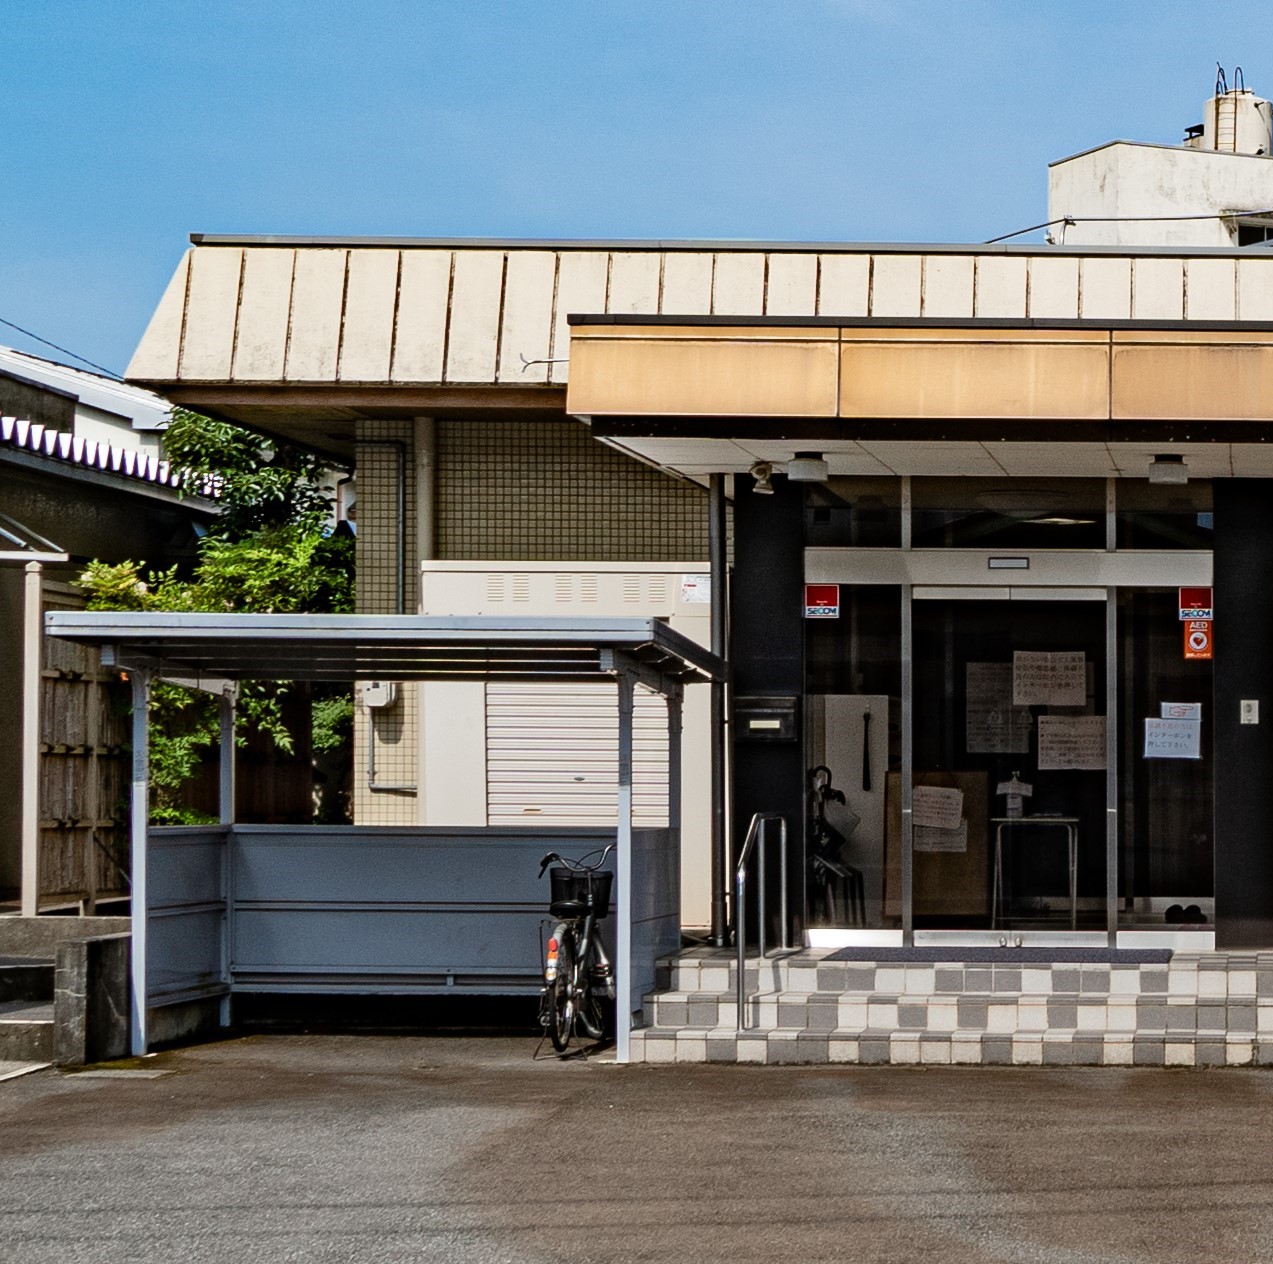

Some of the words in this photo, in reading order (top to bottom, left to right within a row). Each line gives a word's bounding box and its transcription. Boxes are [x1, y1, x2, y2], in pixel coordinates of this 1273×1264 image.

[807, 607, 837, 615] SECOM
[1181, 609, 1211, 617] SECOM
[1189, 621, 1208, 629] AED
